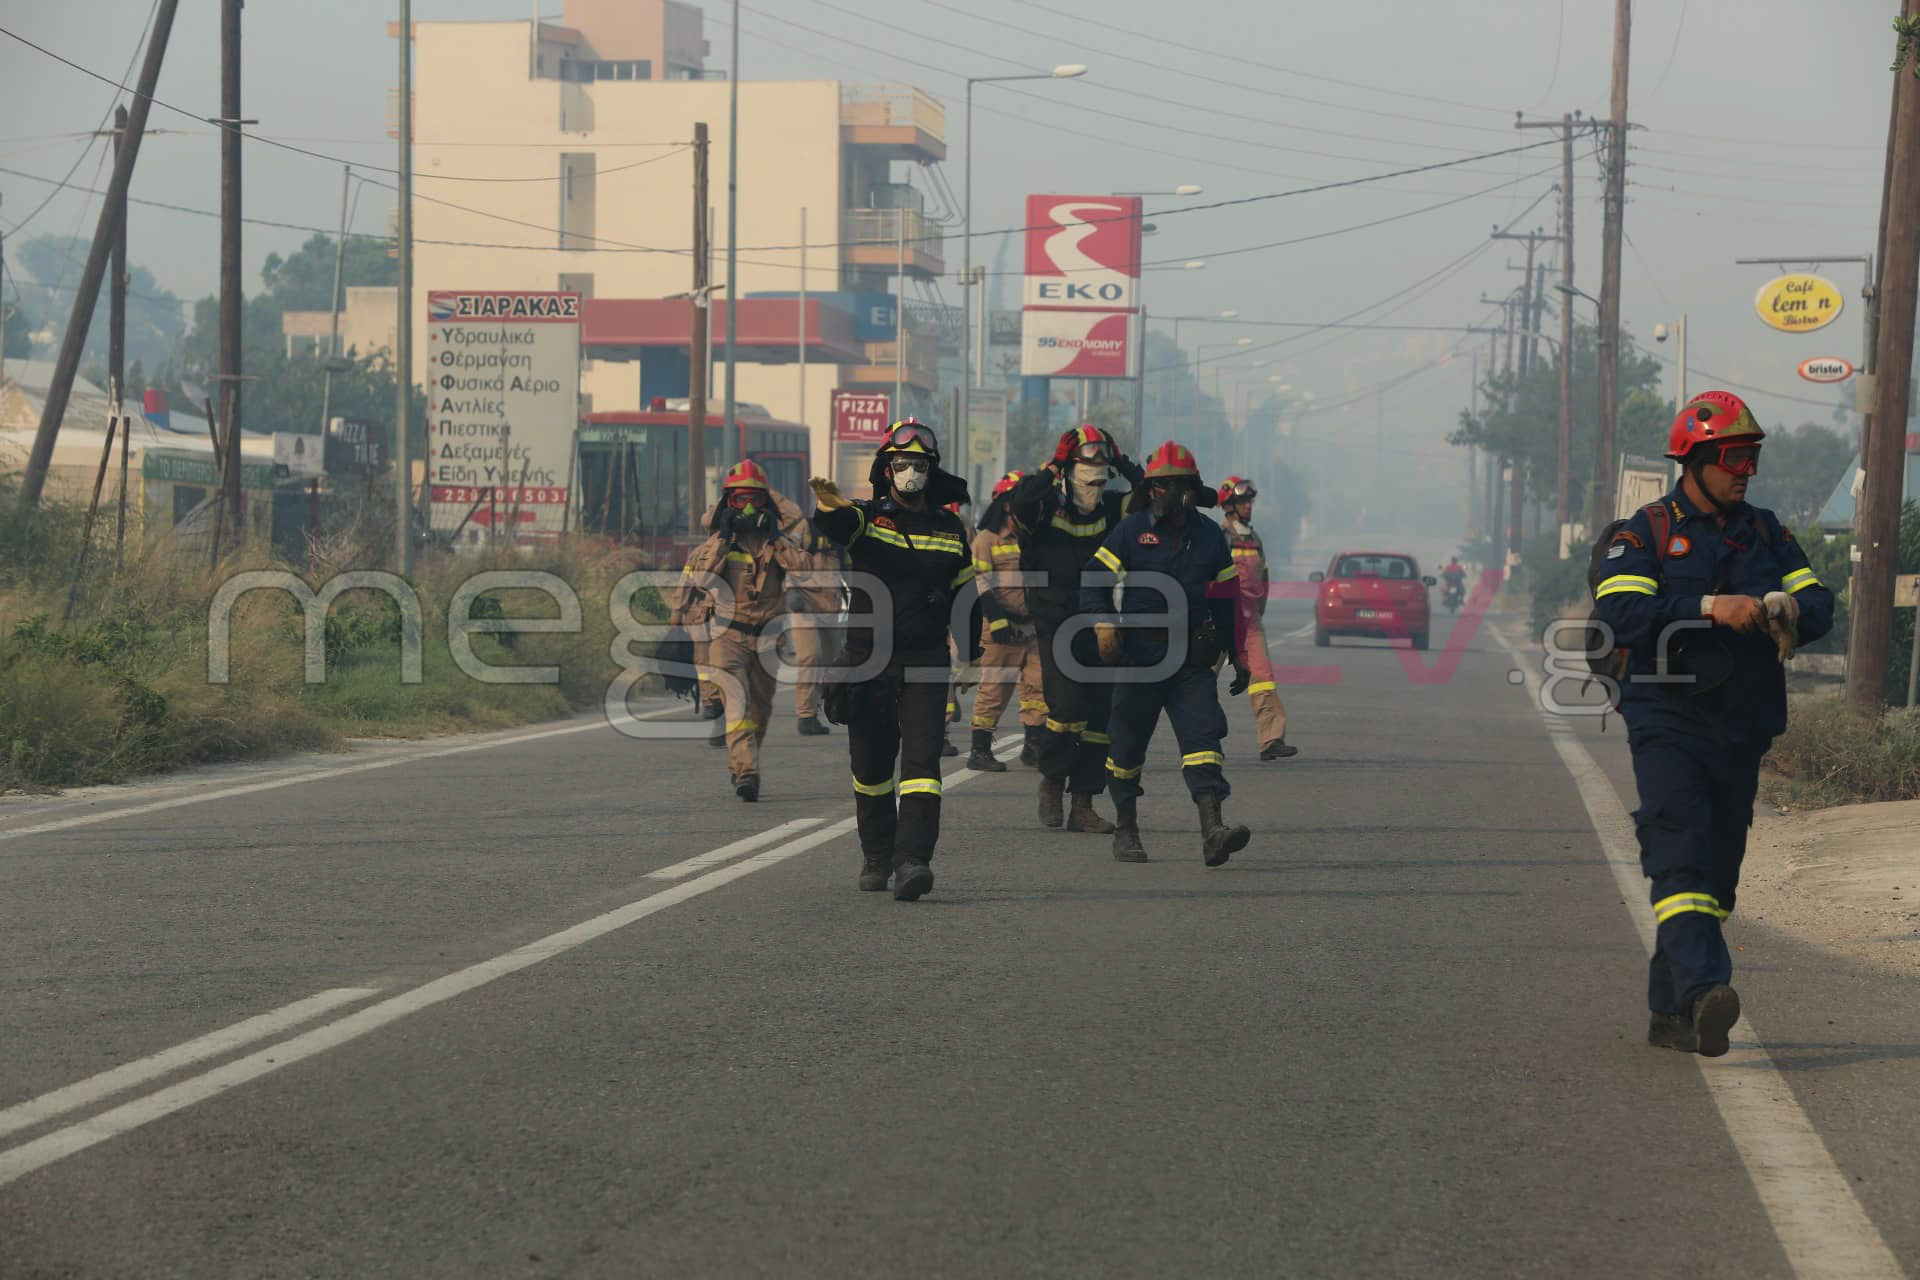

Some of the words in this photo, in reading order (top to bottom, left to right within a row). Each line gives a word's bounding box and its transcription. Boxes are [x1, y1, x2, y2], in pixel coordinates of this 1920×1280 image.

[1039, 283, 1123, 300] EKO
[458, 297, 577, 316] ΣΙΑΡΑΚΑΣ
[441, 327, 535, 347] Υδραυλικά
[440, 350, 532, 370] Θέρμανση
[1808, 363, 1843, 374] bristot
[440, 374, 504, 391] Φυσικό
[510, 375, 560, 396] Αέριο
[440, 397, 505, 417] Αντλίες
[841, 400, 885, 414] PIZZA
[439, 419, 511, 436] Πιεστικά
[440, 442, 531, 462] Δεξαμενές
[439, 465, 477, 484] Είδη
